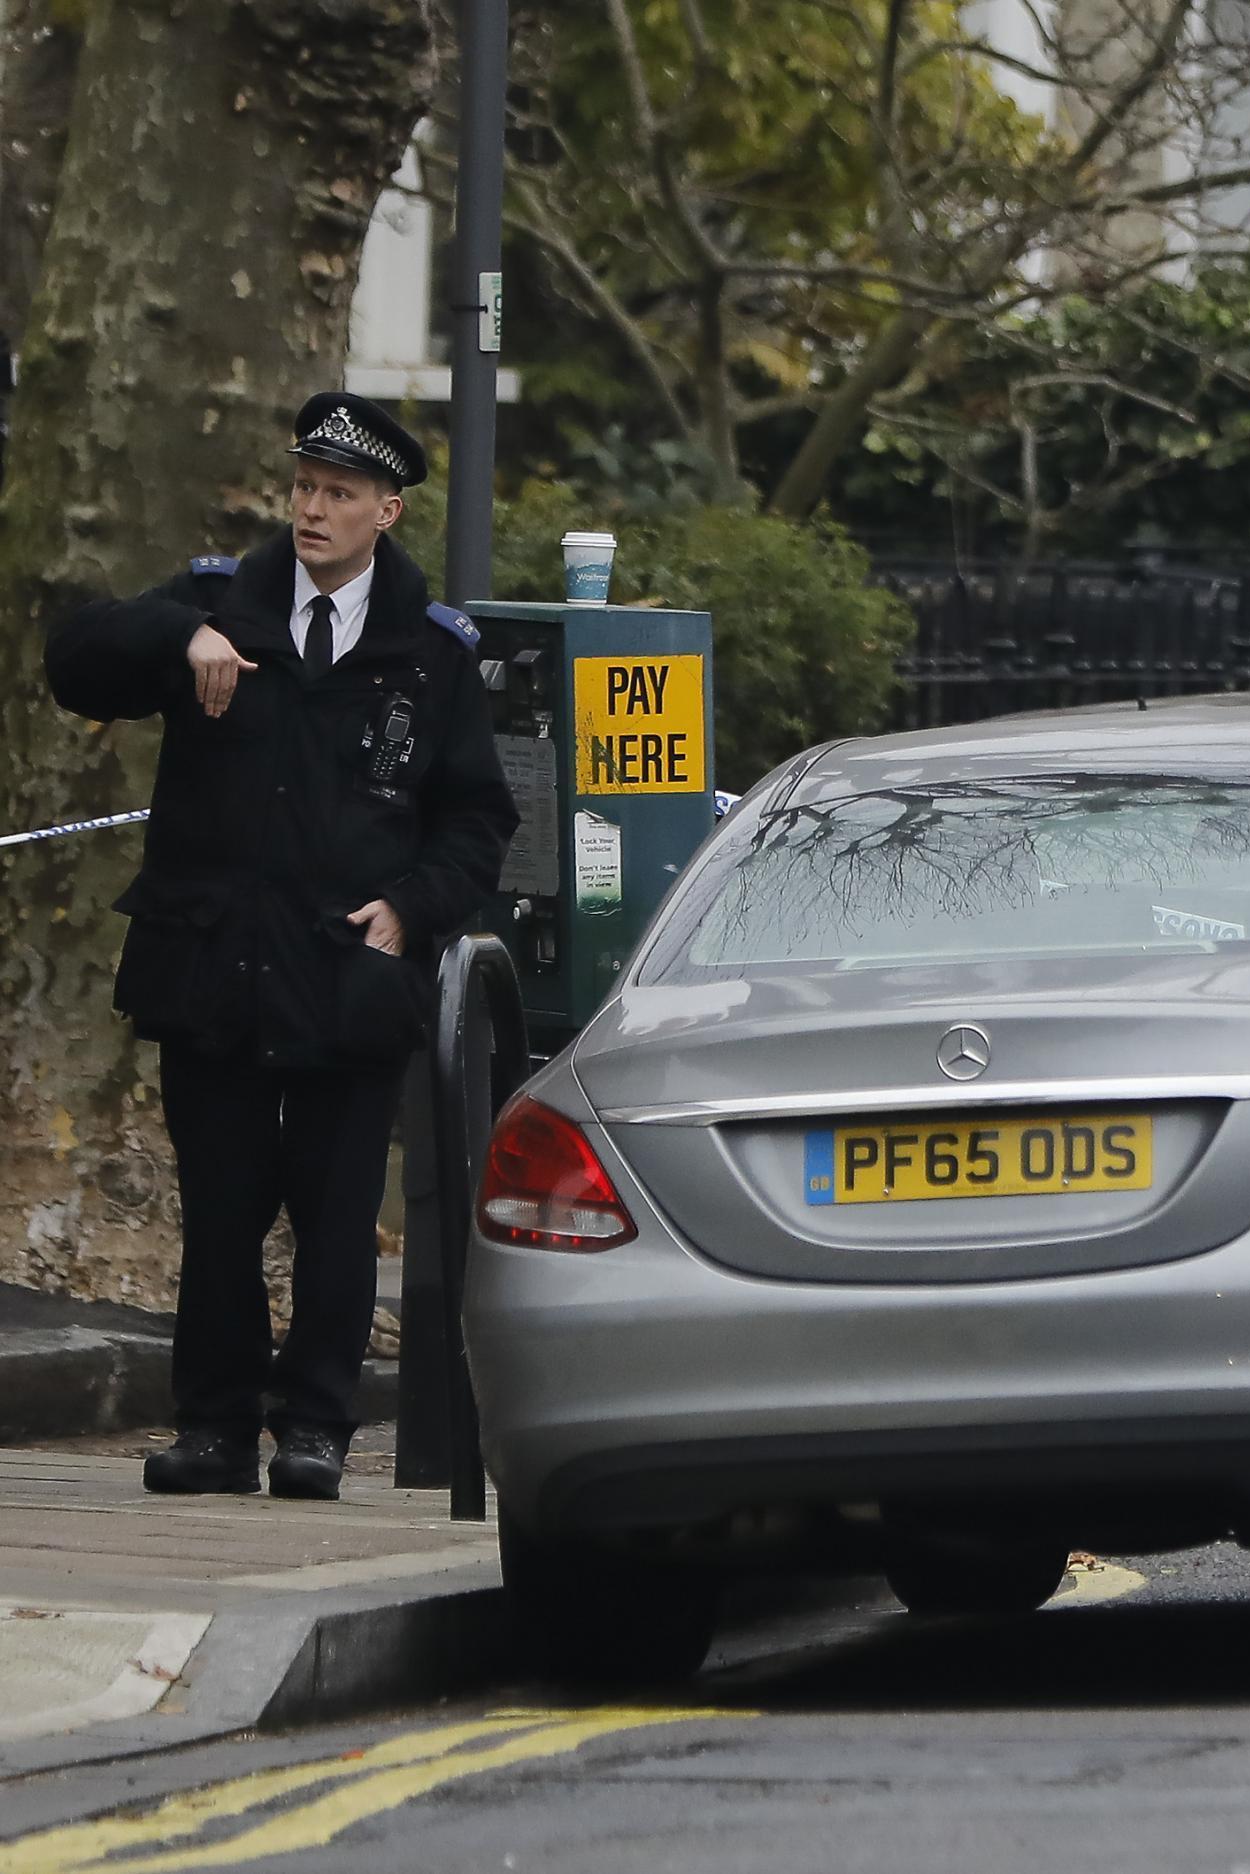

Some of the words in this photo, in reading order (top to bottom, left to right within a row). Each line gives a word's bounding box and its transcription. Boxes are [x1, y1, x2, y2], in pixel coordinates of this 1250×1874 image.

[607, 665, 669, 716] PAY
[591, 733, 688, 785] HERE
[844, 1130, 1000, 1192] PF65
[1019, 1124, 1137, 1182] ODS
